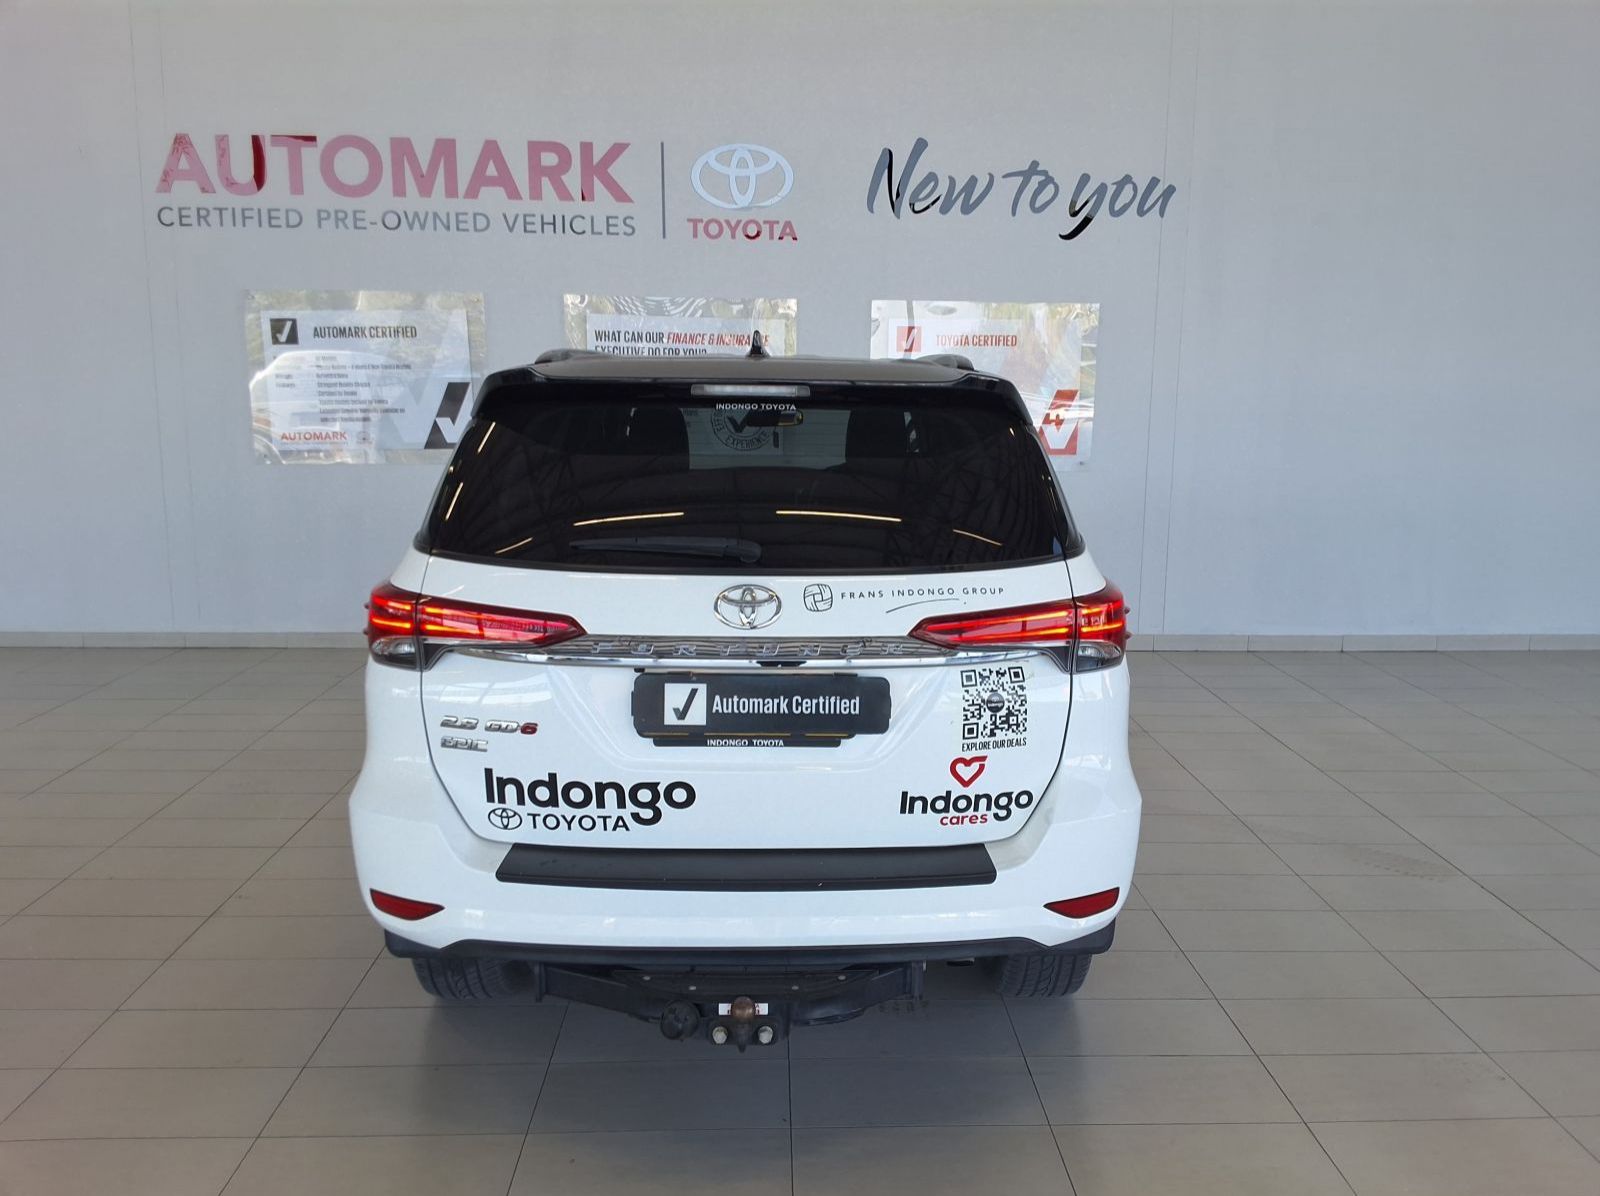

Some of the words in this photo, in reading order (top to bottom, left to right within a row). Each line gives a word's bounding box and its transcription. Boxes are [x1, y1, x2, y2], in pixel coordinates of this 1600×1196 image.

[155, 133, 635, 204] AUTOMARK
[867, 137, 995, 219] New
[1002, 160, 1060, 218] to
[1058, 173, 1177, 241] you
[157, 206, 304, 229] CERTIFIED
[316, 210, 491, 233] PRE-OWNED
[502, 212, 636, 237] VEHICLES
[687, 218, 798, 241] TOYOTA
[313, 326, 367, 339] AUTOMARK
[369, 326, 417, 339] CERTIFIED
[594, 330, 622, 343] WHAT
[623, 330, 644, 343] CAN
[645, 331, 665, 344] OUR
[666, 332, 707, 345] FINANCE
[708, 333, 714, 344] &
[936, 334, 970, 347] TOYOTA
[971, 335, 1018, 347] CERTIFIED
[716, 403, 758, 411] INDONGO
[761, 403, 797, 411] TOYOTA
[281, 431, 347, 441] AUTOMARK
[841, 590, 884, 599] FRANS
[891, 587, 955, 597] INDONGO
[962, 587, 1004, 595] GROUP
[712, 695, 789, 714] Automark
[792, 695, 860, 715] Certified
[707, 739, 749, 747] INDONGO
[752, 739, 784, 747] TOYOTA
[962, 739, 992, 752] EXPLORE
[992, 738, 1006, 750] OUR
[1006, 737, 1027, 748] DEALS
[484, 767, 697, 827] Indongo
[900, 790, 1034, 821] Indongo
[527, 813, 631, 831] TOYOTA
[940, 813, 988, 826] cares
